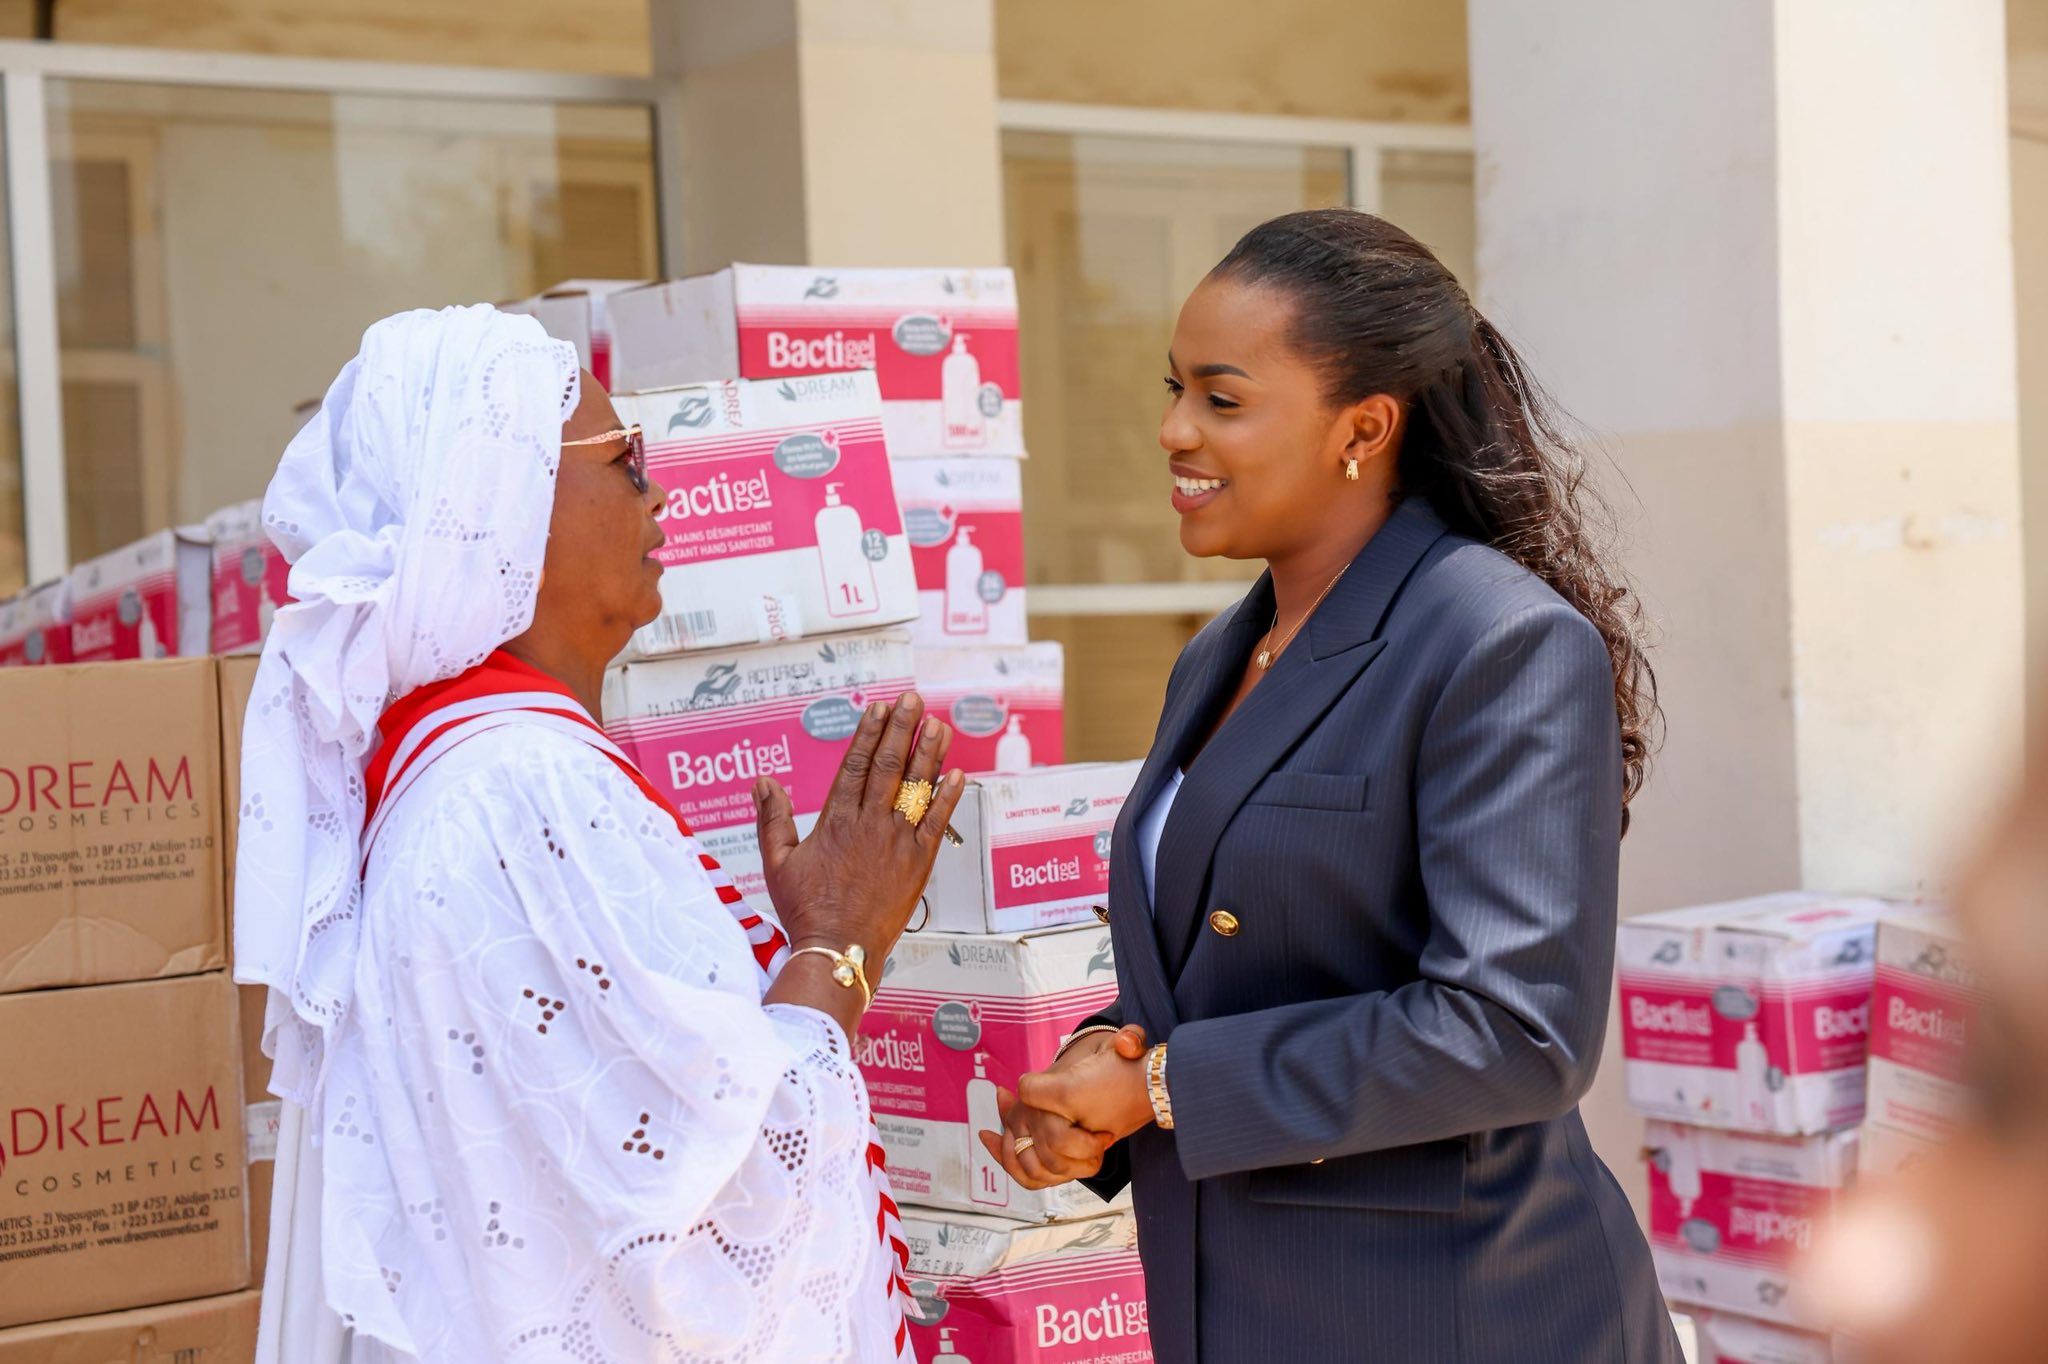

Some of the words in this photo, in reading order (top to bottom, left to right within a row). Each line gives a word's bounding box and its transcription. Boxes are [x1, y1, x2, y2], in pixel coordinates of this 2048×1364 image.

[768, 331, 876, 370] Bactigel
[795, 376, 856, 397] DREAM
[674, 530, 705, 545] MAINS
[705, 520, 773, 540] DÉSINFECTANT
[864, 532, 882, 548] 12
[658, 545, 699, 561] INSTANT
[700, 540, 728, 556] HAND
[727, 535, 775, 551] SANITIZER
[667, 734, 793, 790] Bactigel
[680, 802, 698, 815] GEL
[698, 794, 729, 810] MAINS
[723, 806, 750, 821] HAND
[72, 868, 195, 889] www.dreamcosmetics.net
[1010, 855, 1081, 888] Bactigel
[960, 944, 1007, 964] DREAM
[11, 1085, 220, 1157] DREAM
[15, 1153, 225, 1196] COSMETICS
[982, 1165, 997, 1193] 1L
[0, 1239, 87, 1263] eamcosmetics.net
[96, 1219, 219, 1248] www.dreamcosmetics.net
[1035, 1292, 1149, 1348] Bactige
